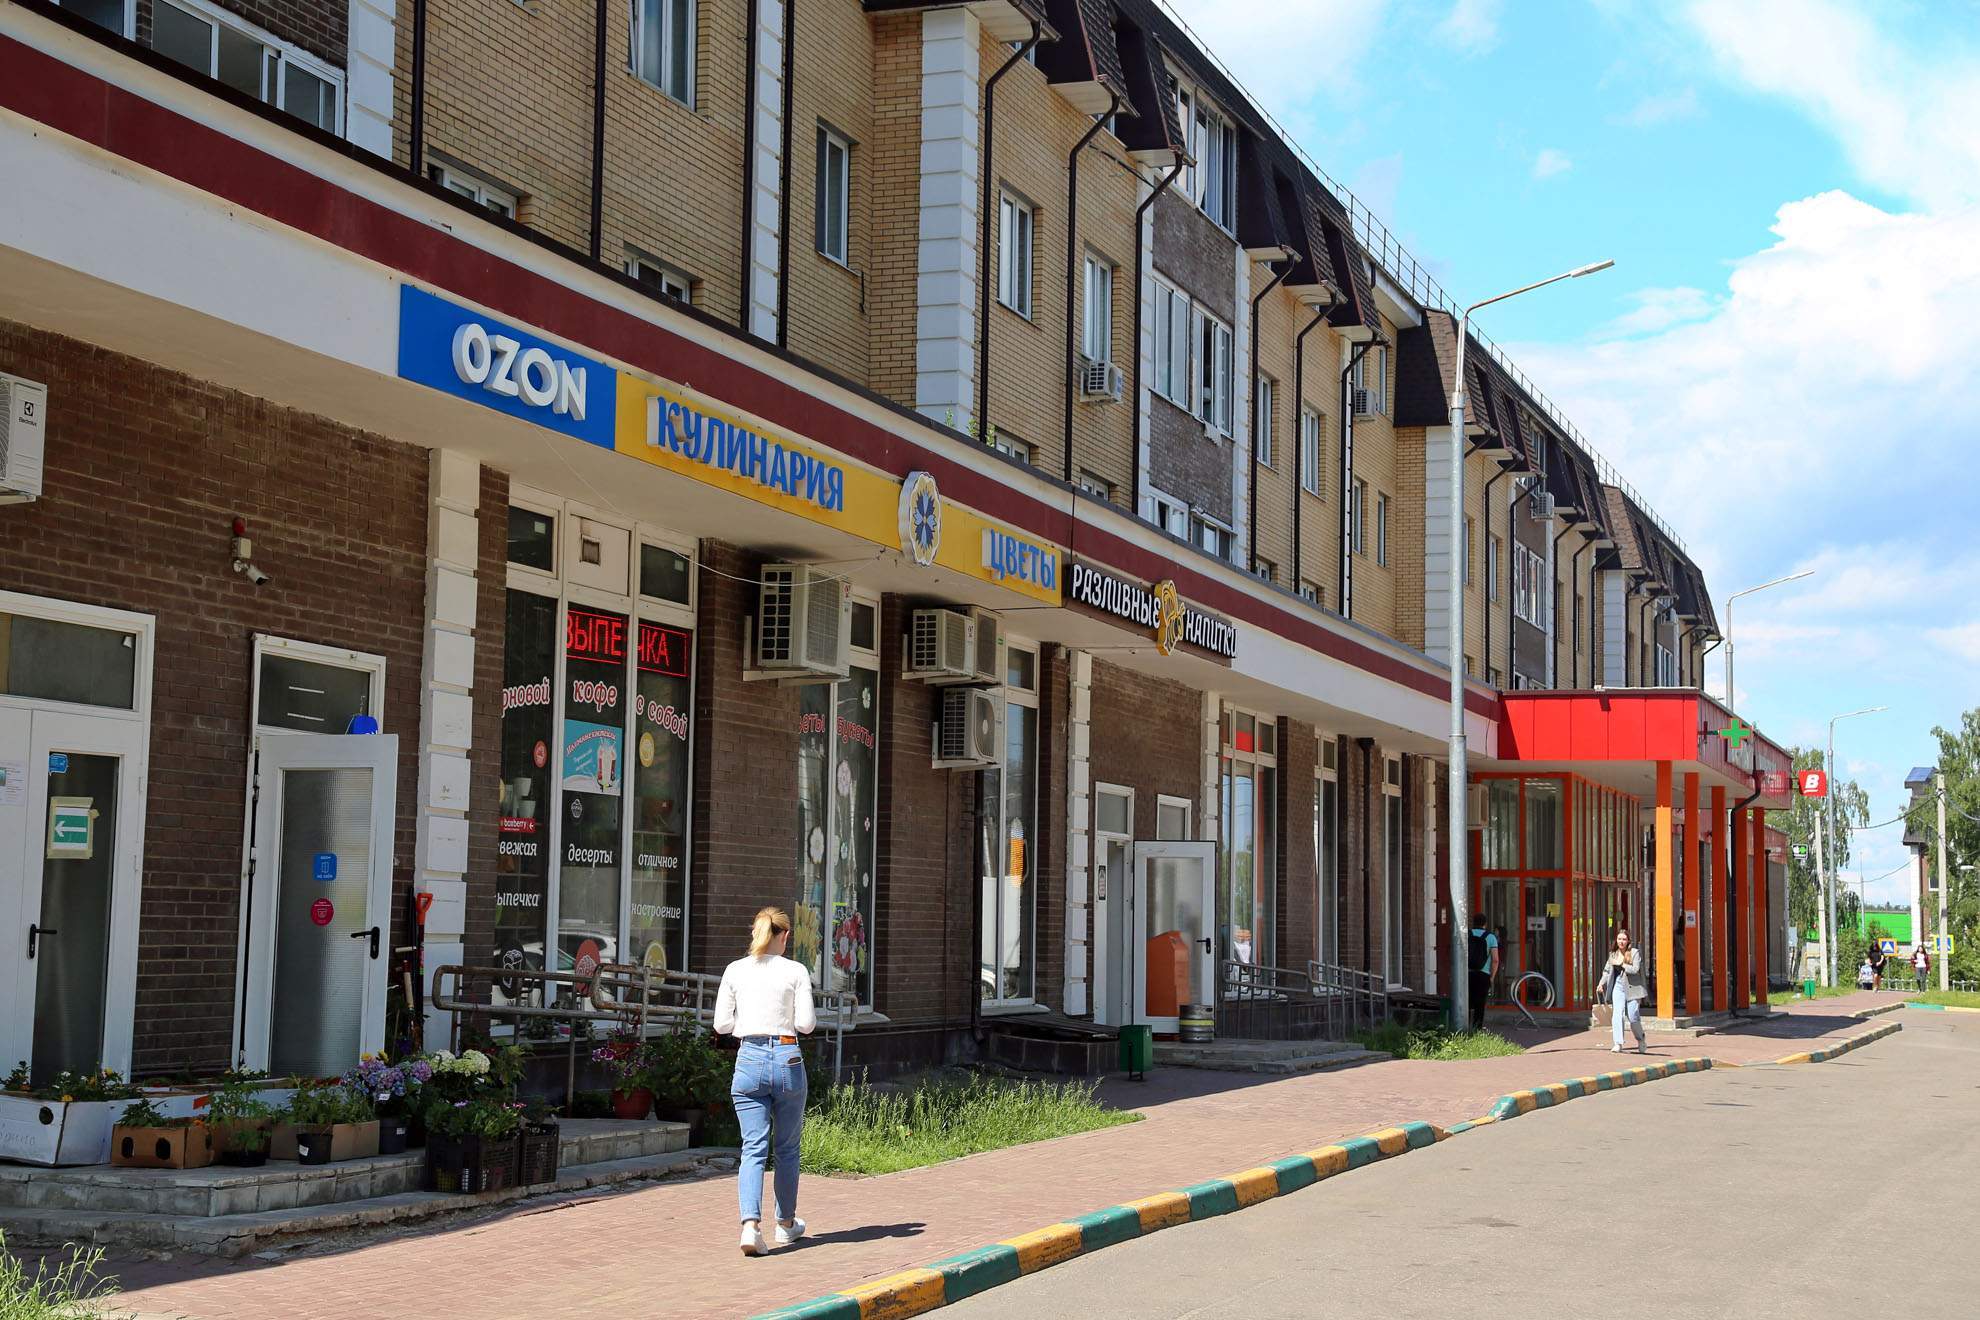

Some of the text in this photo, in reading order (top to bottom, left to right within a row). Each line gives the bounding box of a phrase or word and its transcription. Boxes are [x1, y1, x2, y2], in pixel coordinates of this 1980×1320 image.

[452, 323, 587, 421] OZON
[652, 396, 843, 512] КУЛИНАРИЯ
[988, 527, 1056, 591] ЦВЕТЫ
[1072, 563, 1239, 658] РАЗЛИВНЫЕ НАПИТКИ
[573, 680, 618, 713] кофе
[635, 694, 645, 716] с
[647, 700, 688, 741] собой
[498, 841, 538, 857] вежая
[567, 843, 614, 869] десерты
[638, 853, 679, 870] отличное
[495, 892, 540, 907] ыпечка
[631, 902, 682, 920] настроение
